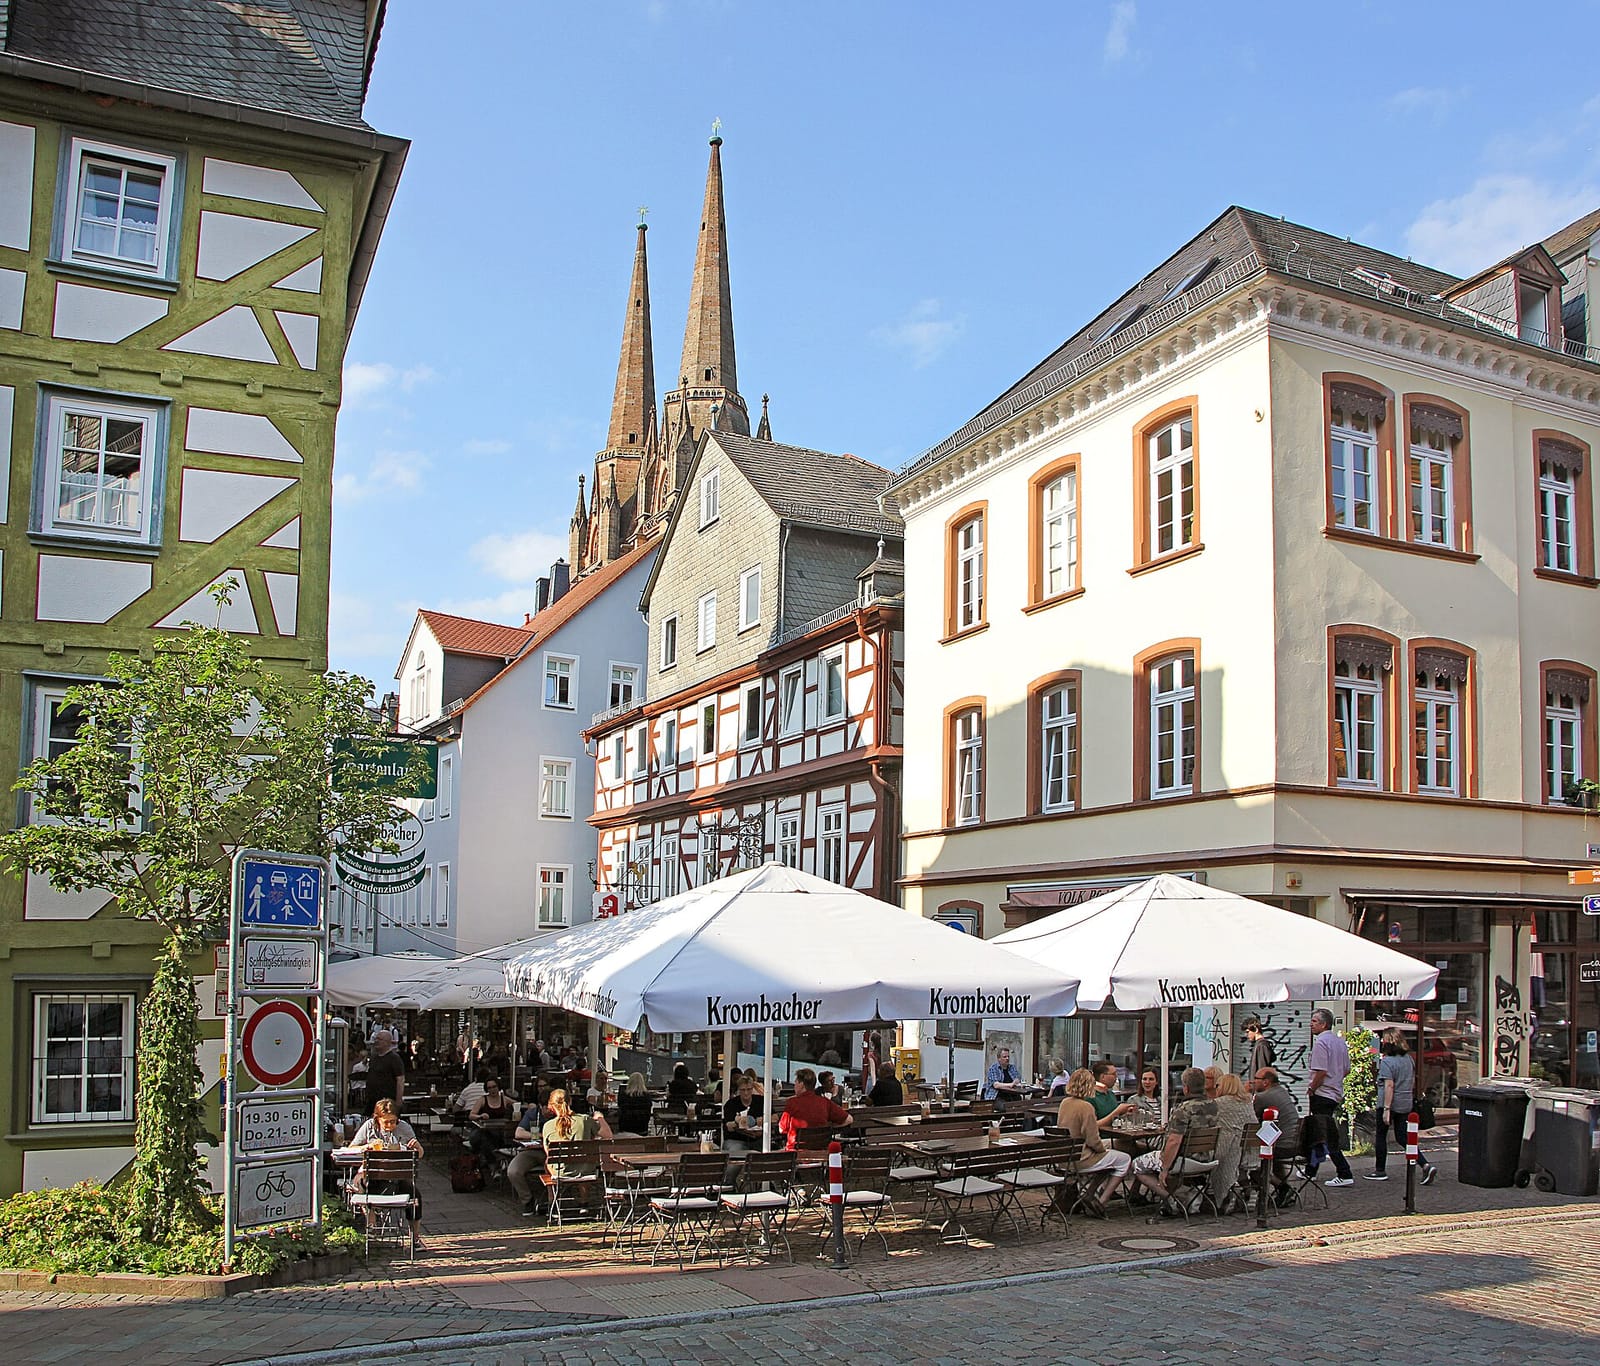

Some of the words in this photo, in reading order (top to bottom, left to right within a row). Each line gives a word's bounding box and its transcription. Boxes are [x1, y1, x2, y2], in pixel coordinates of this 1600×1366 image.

[343, 874, 417, 894] Fremdenzimmer
[1058, 890, 1086, 905] VOLK
[1158, 976, 1245, 1002] Krombacher
[1322, 973, 1400, 997] Krombacher
[706, 992, 822, 1026] Krombacher
[929, 987, 1031, 1015] Krombacher
[245, 1110, 280, 1125] 19.30
[291, 1108, 307, 1121] 6h
[291, 1124, 306, 1137] 6h
[264, 1202, 287, 1218] frei
